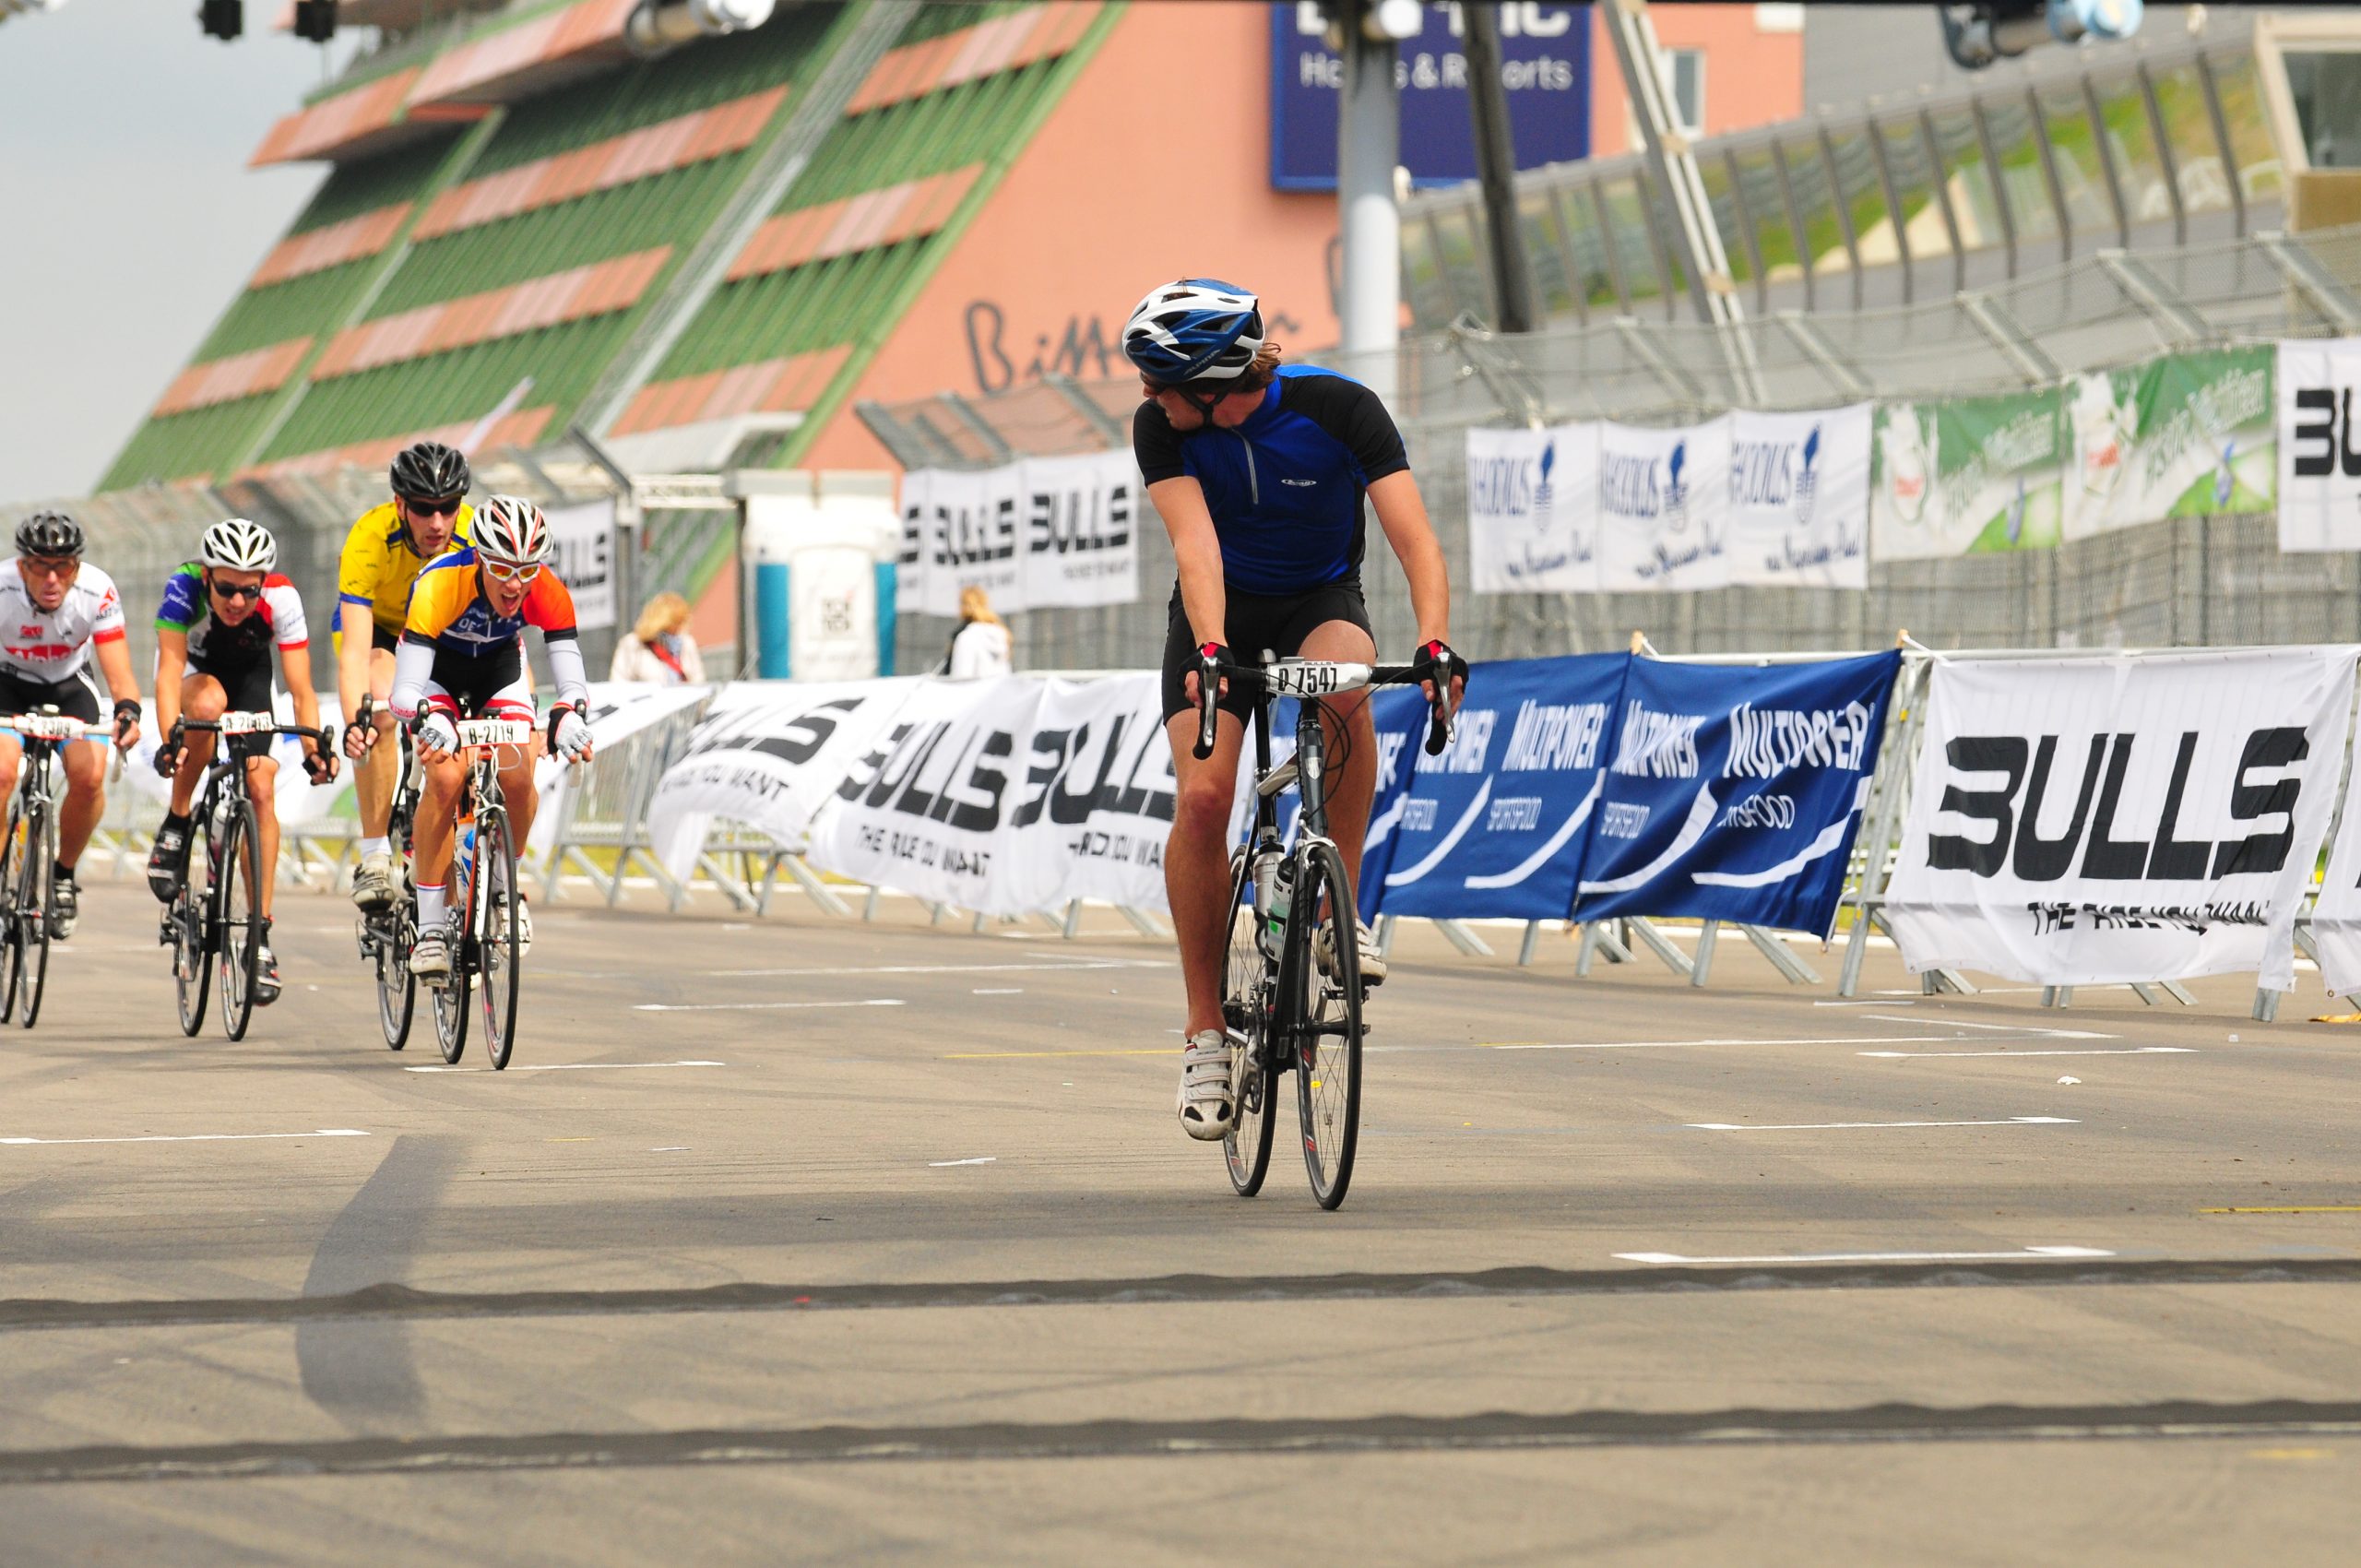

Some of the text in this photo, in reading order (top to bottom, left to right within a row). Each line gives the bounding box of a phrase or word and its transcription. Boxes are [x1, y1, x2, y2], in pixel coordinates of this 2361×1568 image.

[1030, 486, 1128, 553] BULLS
[1297, 667, 1337, 694] 7547
[469, 724, 514, 745] B-2719
[836, 722, 1014, 831] BULLS
[1926, 726, 2309, 882] BULLS
[2027, 901, 2076, 936] THE
